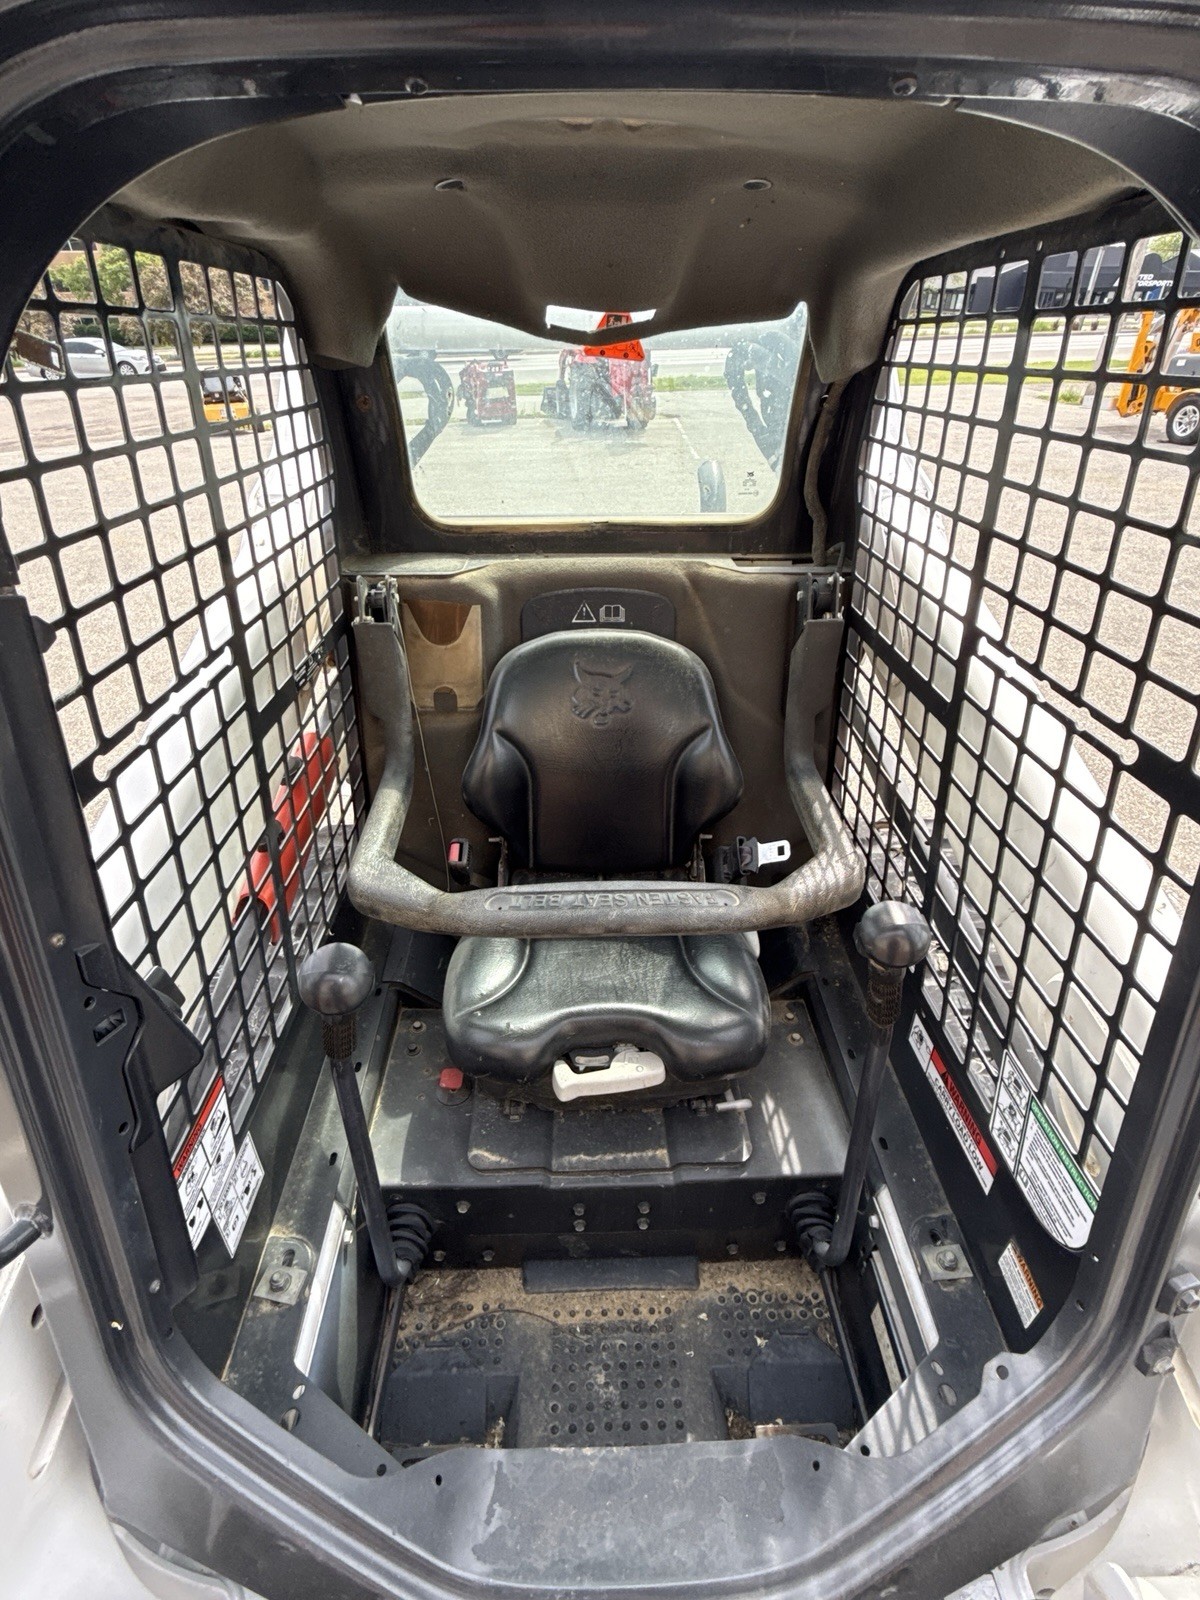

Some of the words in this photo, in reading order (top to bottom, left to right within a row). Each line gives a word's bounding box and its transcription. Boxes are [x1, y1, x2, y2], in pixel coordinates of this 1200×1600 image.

[508, 893, 561, 910] BELT
[568, 892, 628, 908] SEAT
[635, 892, 721, 907] FASTEN
[933, 1077, 952, 1111] CARRY
[951, 1110, 969, 1143] LOAD
[967, 1143, 984, 1171] LOW
[947, 1082, 983, 1147] WARNING
[1031, 1100, 1061, 1151] OPERATION
[177, 1123, 203, 1172] WARNING
[1017, 1254, 1043, 1309] WARNING
